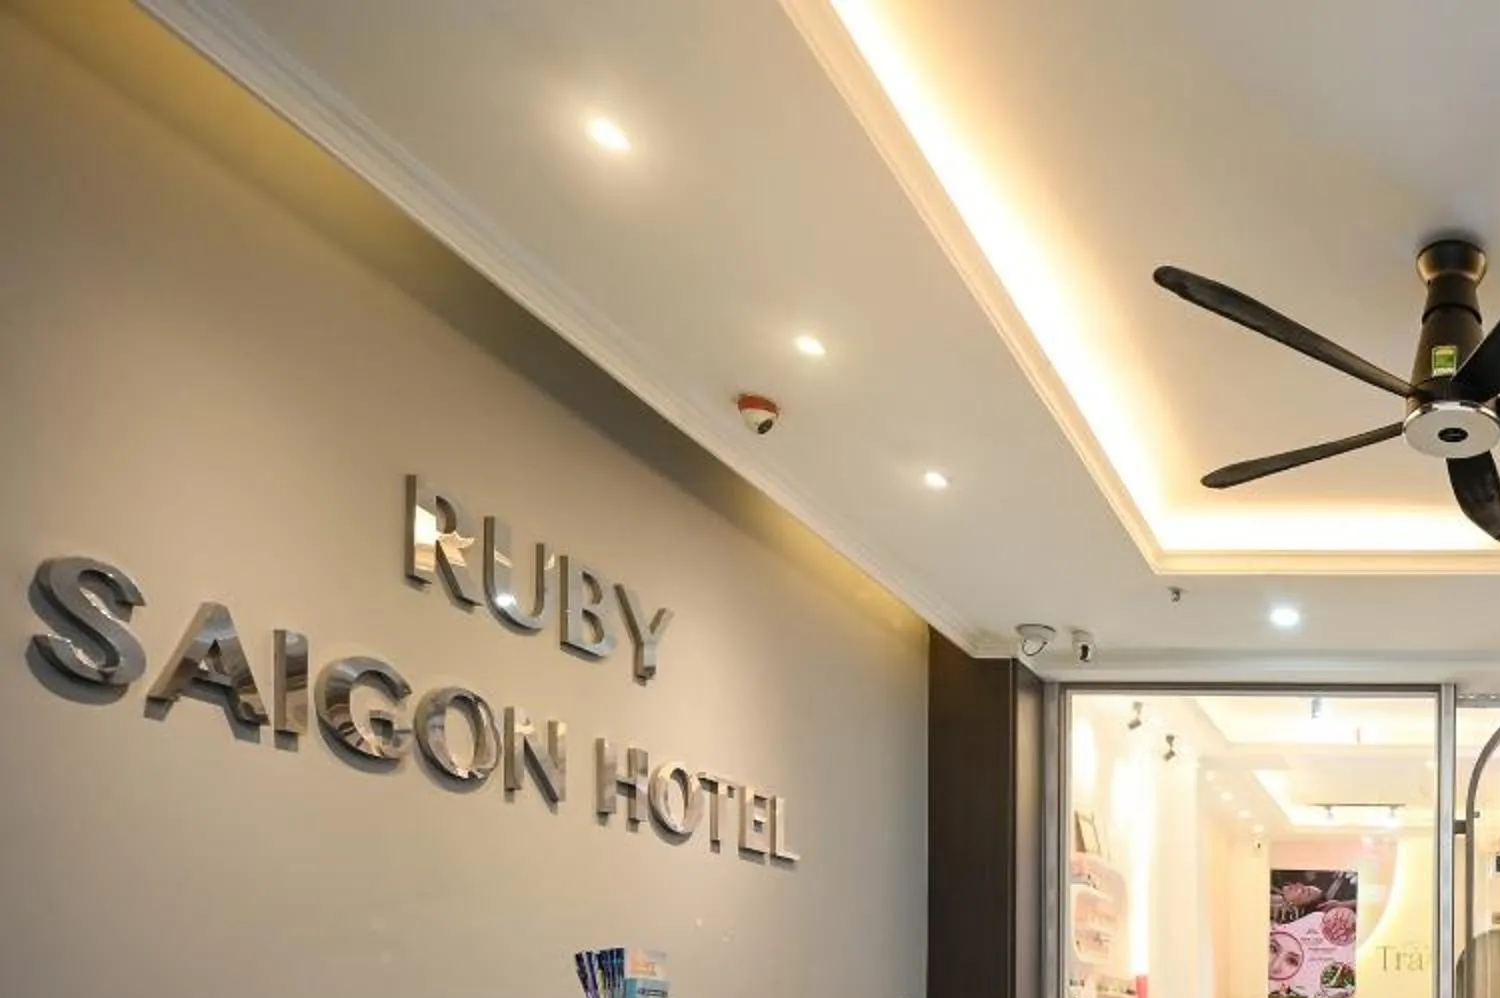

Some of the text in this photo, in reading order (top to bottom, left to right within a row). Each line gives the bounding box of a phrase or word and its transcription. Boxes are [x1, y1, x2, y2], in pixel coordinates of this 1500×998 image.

[405, 474, 675, 684] RUBY
[26, 556, 798, 862] SAIGON HOTEL
